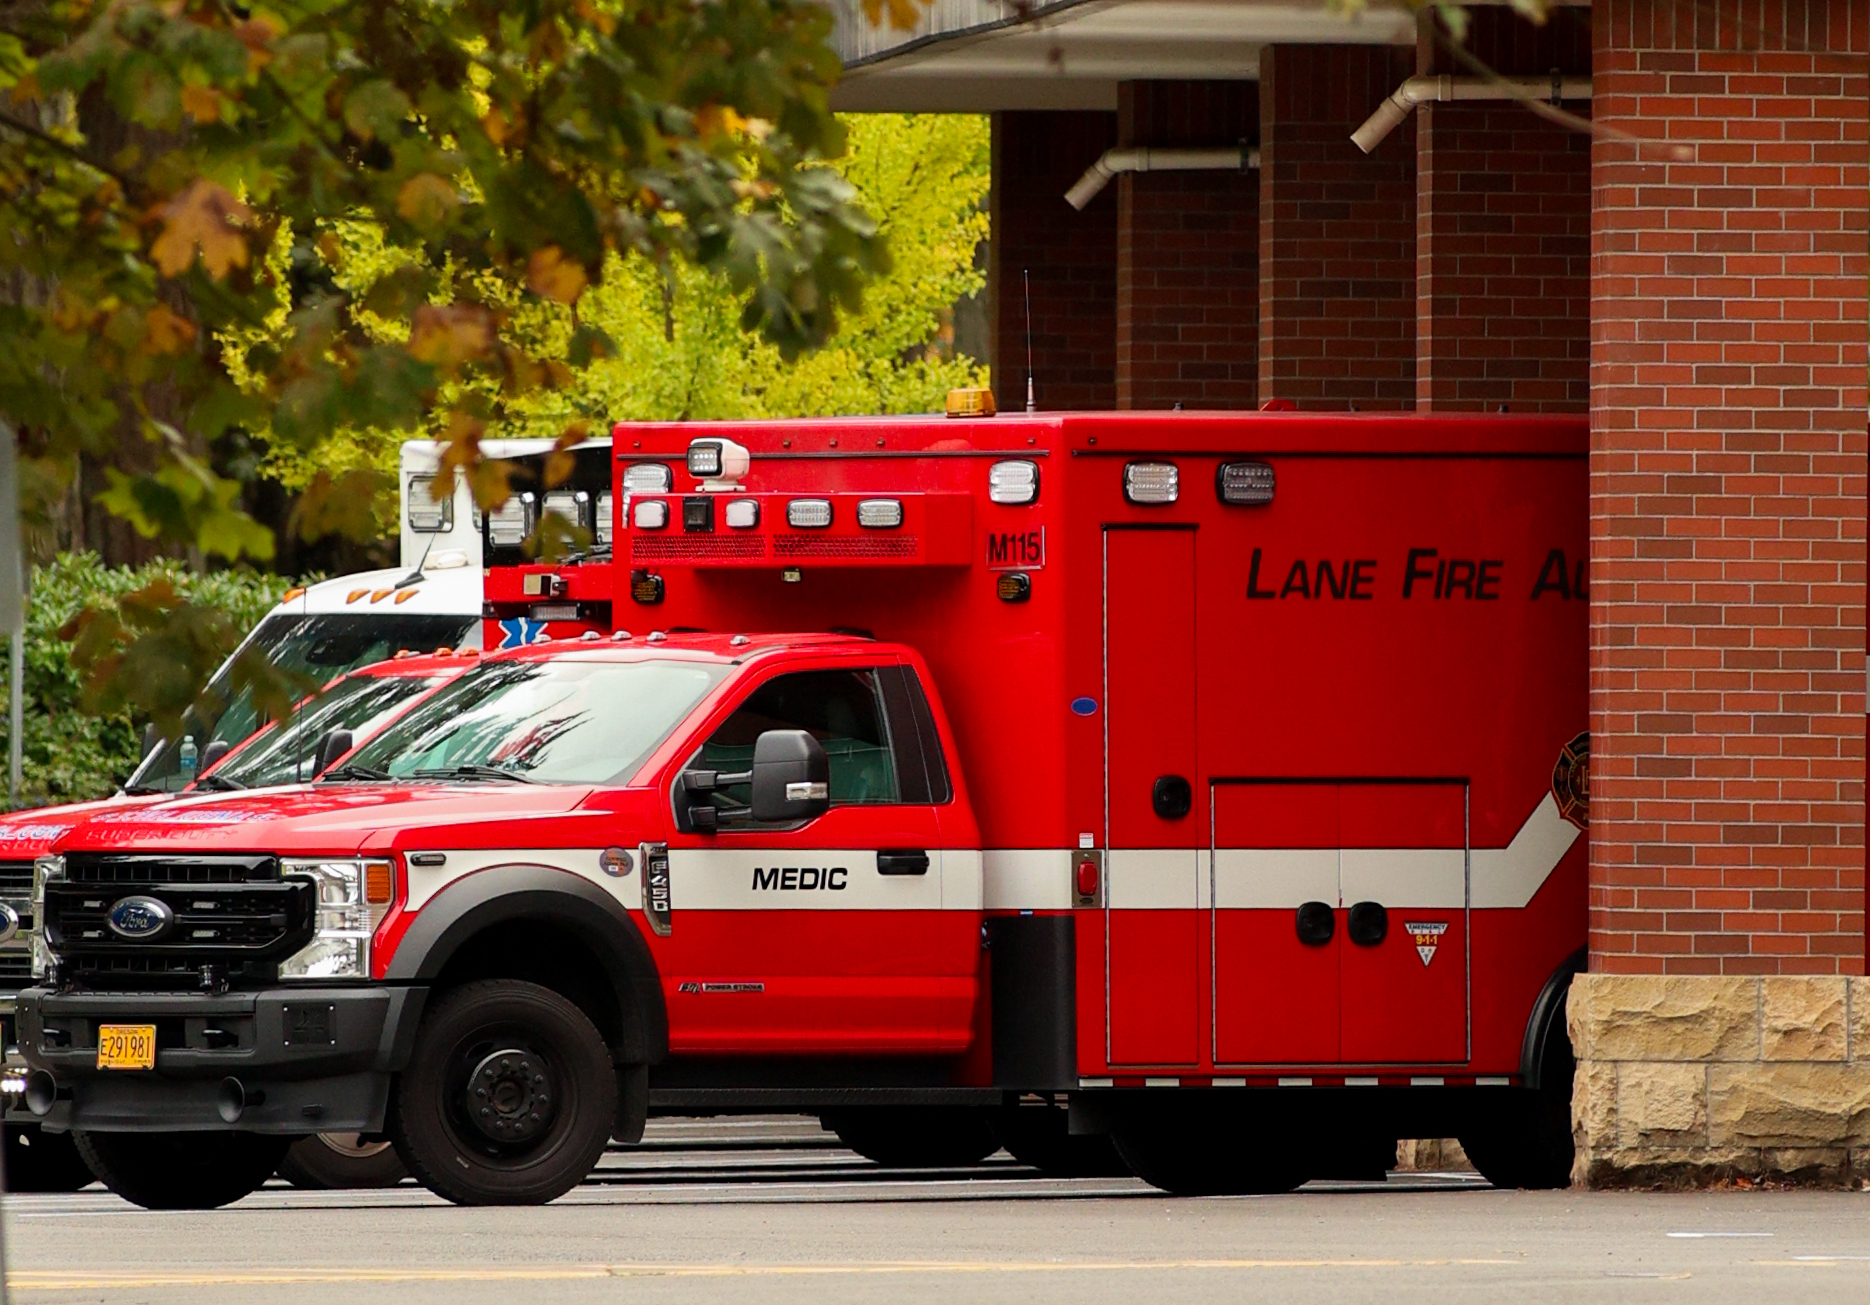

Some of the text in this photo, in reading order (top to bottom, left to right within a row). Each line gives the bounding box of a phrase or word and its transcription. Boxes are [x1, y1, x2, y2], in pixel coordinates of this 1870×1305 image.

[989, 532, 1040, 563] M115
[1246, 547, 1378, 600] LANE
[1402, 547, 1504, 600] FIRE
[751, 867, 848, 890] MEDIC
[120, 909, 150, 928] Ford
[100, 1036, 150, 1059] E291981
